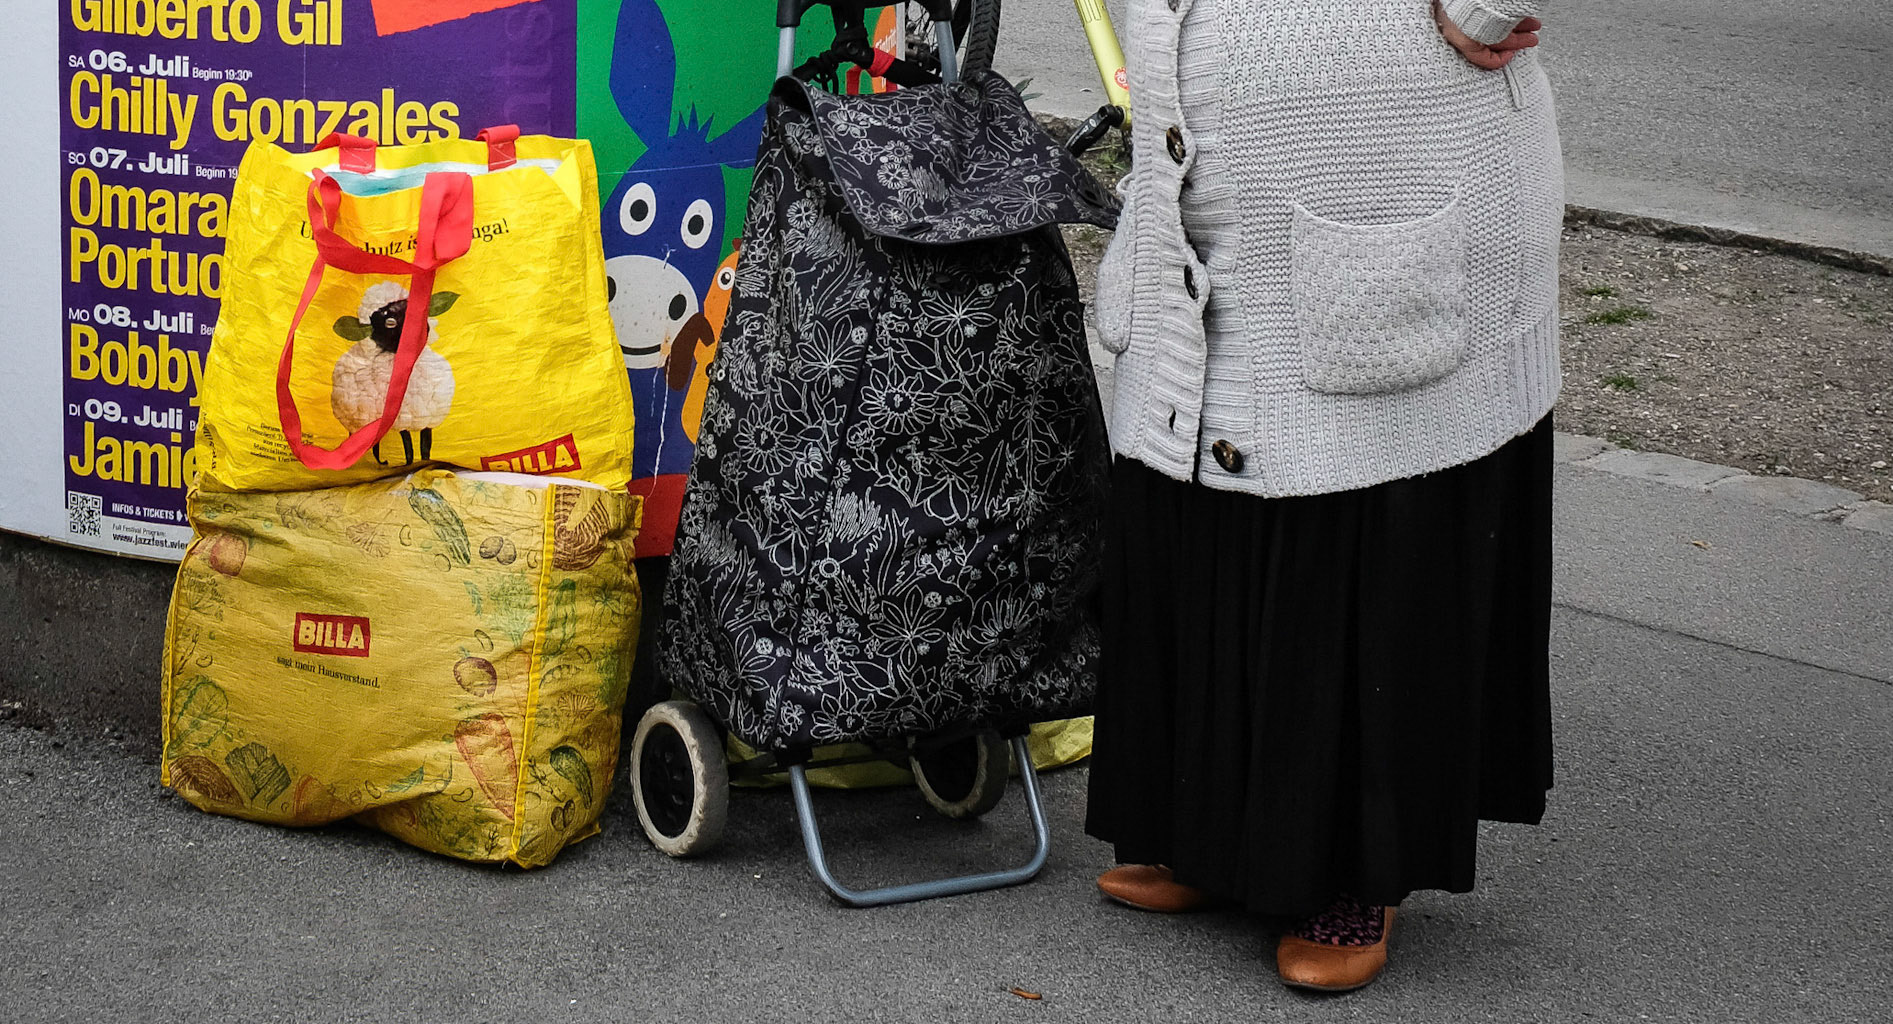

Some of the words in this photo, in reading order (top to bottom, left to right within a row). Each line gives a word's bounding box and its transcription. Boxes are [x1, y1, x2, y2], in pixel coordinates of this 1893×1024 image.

[68, 55, 86, 69] SA
[88, 49, 133, 73] 06.
[139, 54, 190, 77] Juli
[192, 67, 223, 81] Beginn
[70, 70, 199, 150] Chilly
[211, 81, 460, 146] Gonzales
[68, 152, 86, 166] SO
[89, 146, 133, 171] 07.
[138, 152, 189, 175] Juli
[195, 166, 226, 180] Beginn
[69, 167, 228, 238] Omara
[69, 307, 89, 322] MO
[93, 303, 138, 328] 08.
[143, 310, 193, 334] Juli
[70, 323, 205, 407] Bobby
[69, 403, 80, 417] DI
[84, 398, 128, 423] 09.
[133, 405, 183, 430] Juli
[69, 421, 198, 489] Jamie
[488, 444, 575, 473] BILLA
[112, 502, 134, 515] INFOS
[135, 507, 141, 516] &
[142, 507, 174, 520] TICKETS
[122, 525, 141, 534] Festival
[298, 619, 365, 650] BILLA
[277, 656, 292, 668] sagt
[295, 660, 316, 673] mein
[318, 665, 381, 689] Hausverstand.
